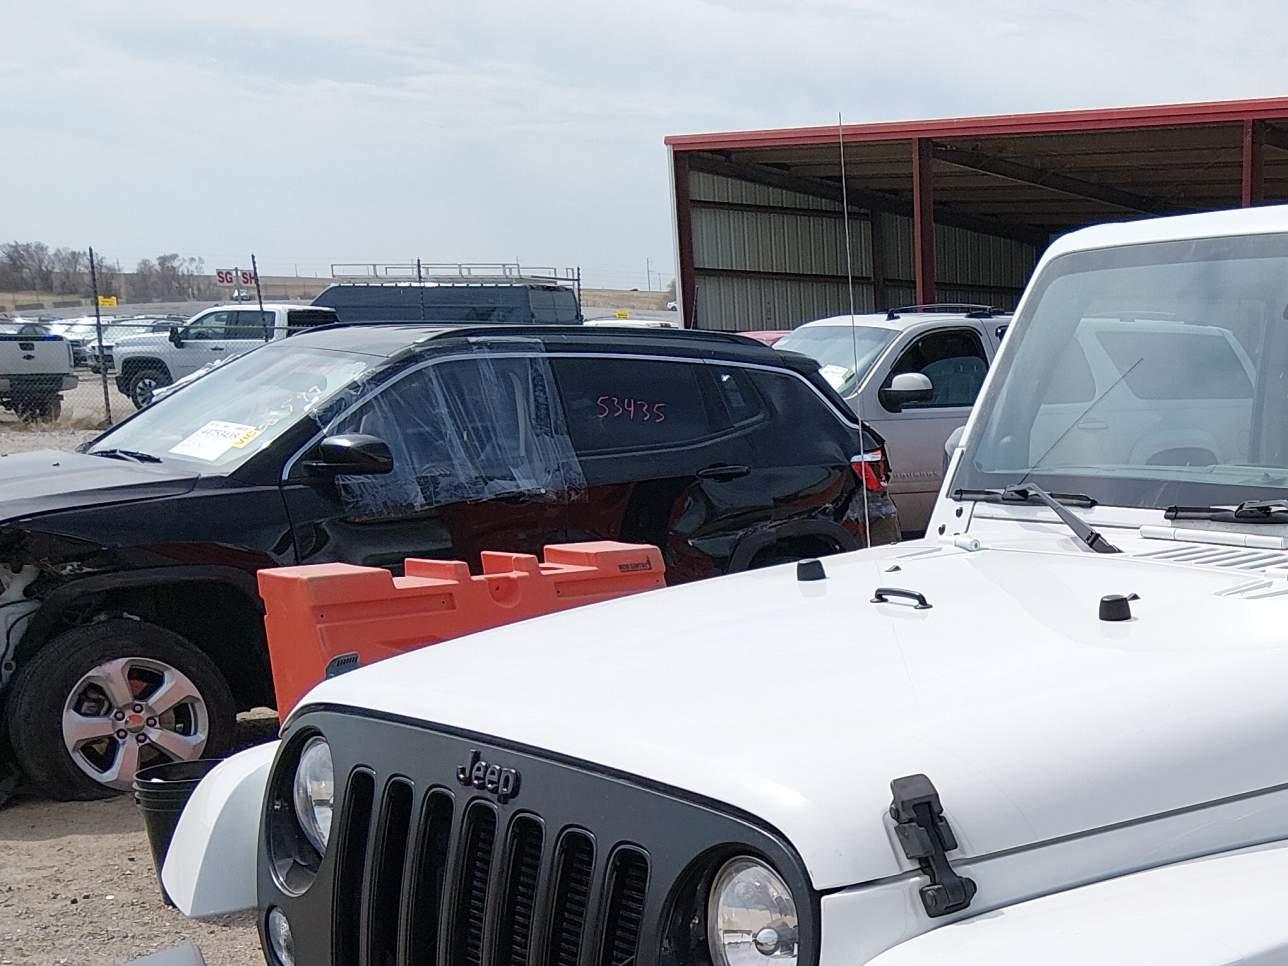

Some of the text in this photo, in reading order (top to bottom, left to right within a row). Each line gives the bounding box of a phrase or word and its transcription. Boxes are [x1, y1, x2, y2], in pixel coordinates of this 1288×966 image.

[217, 271, 233, 284] SG
[597, 396, 665, 423] 53435
[457, 749, 522, 804] Jeep
